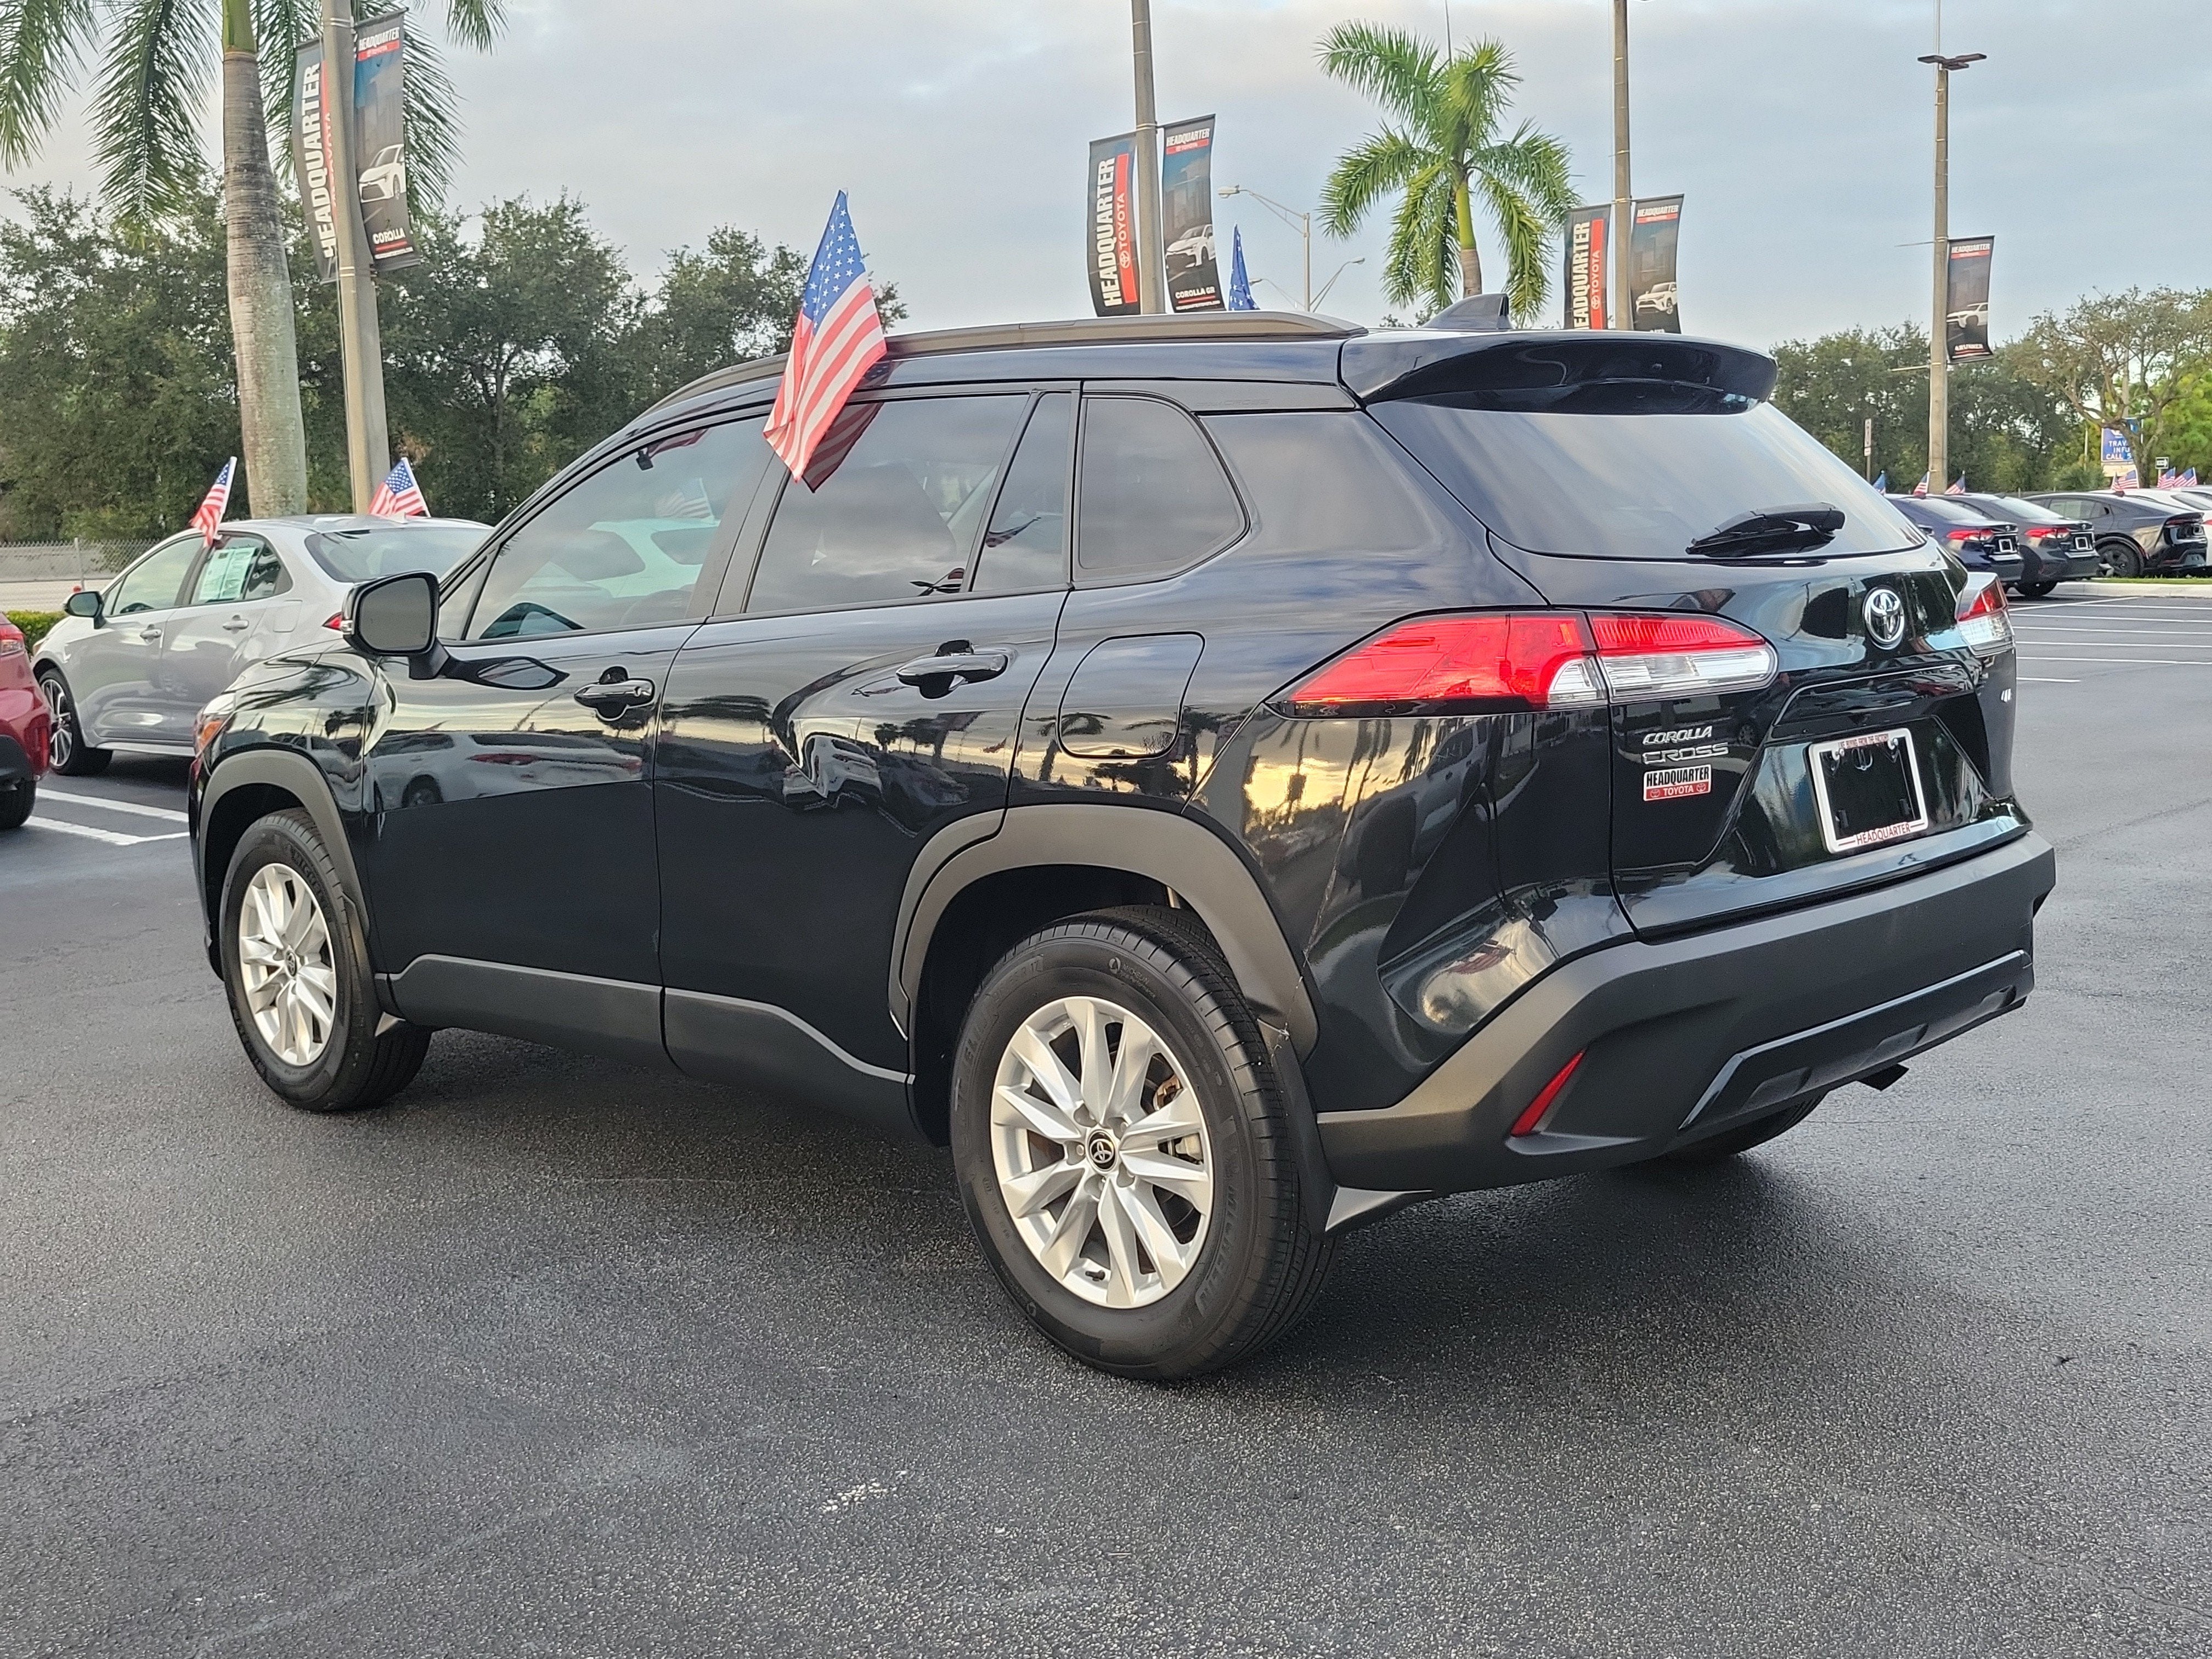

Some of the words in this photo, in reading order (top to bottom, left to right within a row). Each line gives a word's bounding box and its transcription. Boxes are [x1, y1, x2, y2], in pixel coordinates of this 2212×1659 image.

[302, 63, 336, 258] HEADQUARTER
[1096, 157, 1122, 307] HEADQUARTER
[1116, 192, 1128, 251] TOYOTA
[373, 227, 405, 245] COROLLA
[1572, 222, 1590, 329] EADQUARTER
[1592, 250, 1601, 294] TOYOTA
[1175, 287, 1206, 300] COROLLA
[1643, 725, 1713, 746] COROLLA
[1642, 742, 1729, 765] CROSS
[1646, 766, 1709, 787] HEADQUARTER
[1663, 785, 1694, 797] TOYOTA
[1856, 823, 1911, 845] HEADQUARTER
